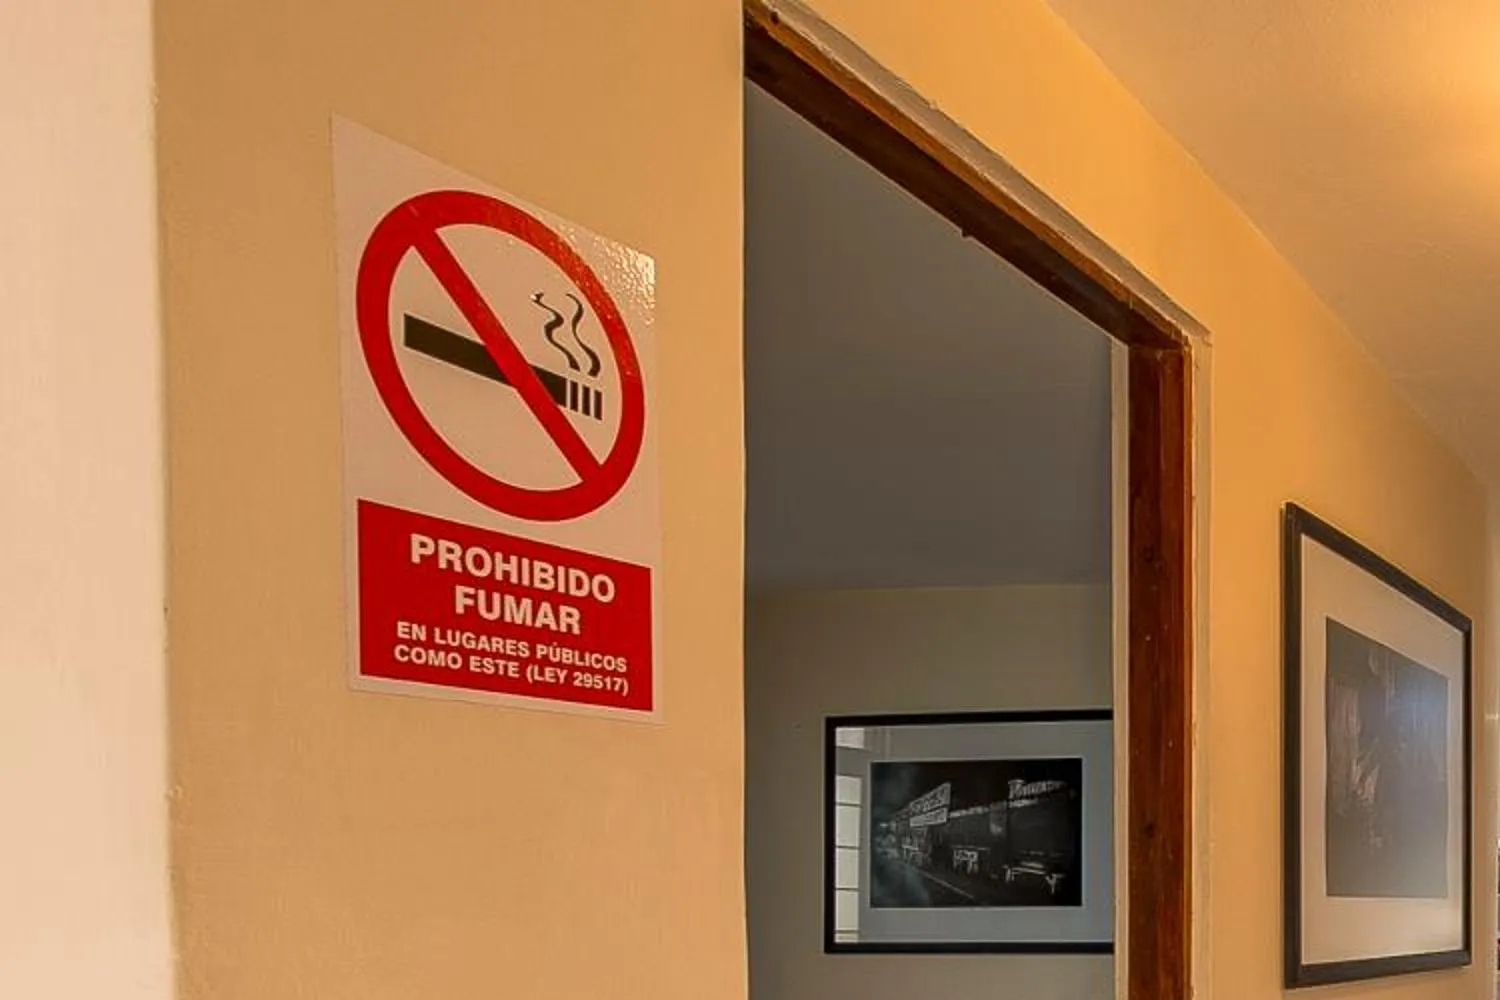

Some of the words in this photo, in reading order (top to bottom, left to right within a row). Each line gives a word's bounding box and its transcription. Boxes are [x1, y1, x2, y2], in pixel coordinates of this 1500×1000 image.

[410, 533, 615, 603] PROHIBIDO
[455, 585, 581, 635] FUMAR
[394, 644, 462, 670] COMO
[469, 657, 520, 678] ESTE
[526, 665, 568, 685] (LEY
[573, 670, 629, 697] 29517)
[396, 621, 427, 642] EN
[434, 628, 529, 658] LUGARES
[536, 641, 627, 673] PÚBLICOS
